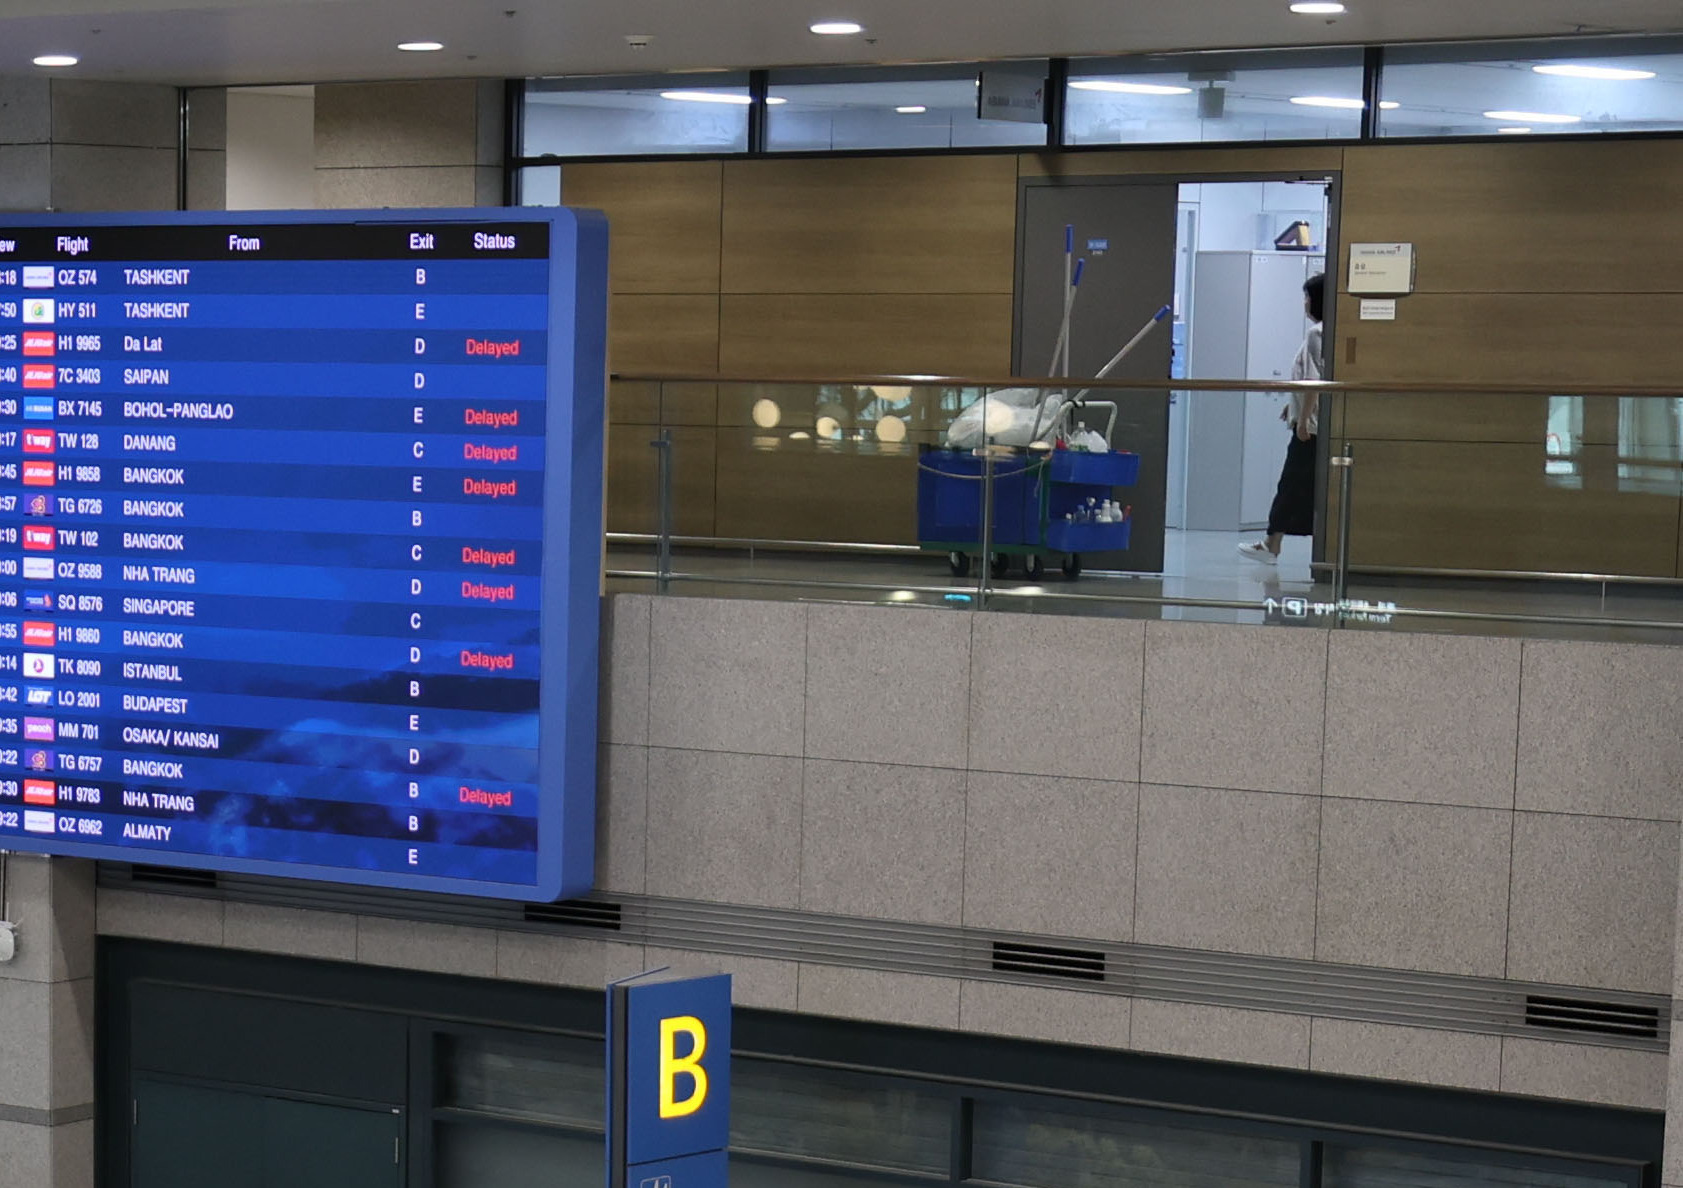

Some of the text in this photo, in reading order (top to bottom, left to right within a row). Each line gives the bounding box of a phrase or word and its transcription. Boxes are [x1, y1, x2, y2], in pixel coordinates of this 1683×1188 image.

[57, 236, 89, 256] Flight
[229, 235, 260, 251] From
[410, 233, 434, 250] Exit
[474, 232, 515, 249] Status
[58, 269, 76, 285] OZ
[78, 269, 97, 285] 574
[123, 269, 190, 285] TASHKENT
[416, 268, 426, 285] B
[123, 302, 190, 319] TASHKENT
[58, 335, 73, 350] H1
[76, 335, 101, 351] 9965
[124, 335, 141, 352] Da
[143, 336, 163, 352] Lat
[415, 338, 426, 354] D
[466, 338, 520, 358] Delayed
[123, 368, 169, 385] SAIPAN
[58, 400, 75, 416] BX
[77, 400, 102, 417] 7145
[123, 401, 234, 420] BOHOL-PANGLAO
[413, 407, 424, 424] E
[465, 408, 519, 429] Delayed
[123, 434, 176, 452] DANANG
[58, 465, 72, 481] H1
[75, 466, 101, 482] 9858
[123, 467, 184, 485] BANGKOK
[412, 476, 422, 493] E
[463, 478, 517, 499] Delayed
[123, 500, 184, 518] BANGKOK
[123, 532, 184, 550] BANGKOK
[57, 562, 76, 578] OZ
[77, 563, 103, 580] 9588
[123, 565, 150, 582] NHA
[151, 566, 195, 584] TRANG
[411, 578, 422, 595] D
[461, 581, 515, 602] Delayed
[123, 597, 195, 617] SINGAPORE
[123, 630, 183, 649] BANGKOK
[58, 658, 75, 674] TK
[76, 659, 101, 676] 8090
[123, 662, 183, 682] ISTANBUL
[410, 680, 420, 697] B
[123, 694, 188, 714] BUDAPEST
[122, 726, 219, 749] OSAKA/ KANSAI
[58, 753, 76, 770] TG
[77, 755, 103, 772] 6757
[123, 758, 183, 779] BANGKOK
[409, 782, 419, 798] B
[459, 786, 512, 808] Delayed
[123, 790, 195, 812] NHA TRANG
[123, 822, 172, 841] ALMATY
[659, 1016, 707, 1118] B
